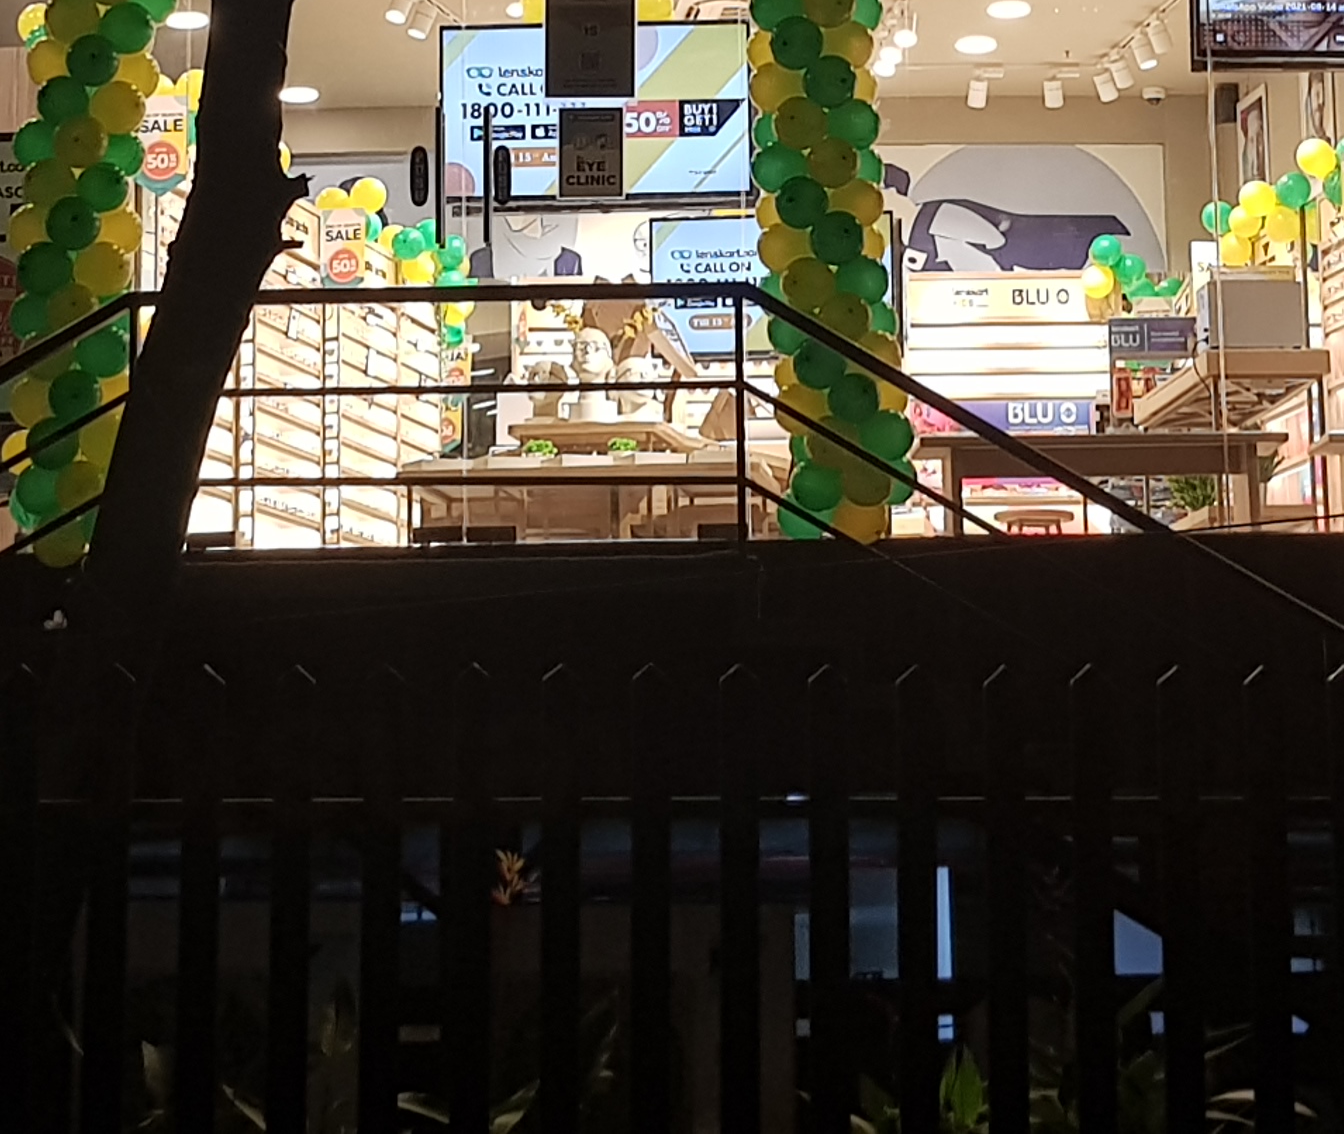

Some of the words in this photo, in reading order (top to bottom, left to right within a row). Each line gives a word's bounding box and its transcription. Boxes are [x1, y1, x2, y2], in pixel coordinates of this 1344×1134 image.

[496, 83, 538, 97] CALL
[139, 118, 184, 134] SALE
[576, 160, 606, 172] EYE
[565, 174, 617, 186] CLINIC
[325, 228, 362, 242] SALE
[694, 262, 726, 274] CALL
[729, 261, 752, 273] ON
[1012, 287, 1050, 306] BLU
[1007, 401, 1054, 425] BLU
